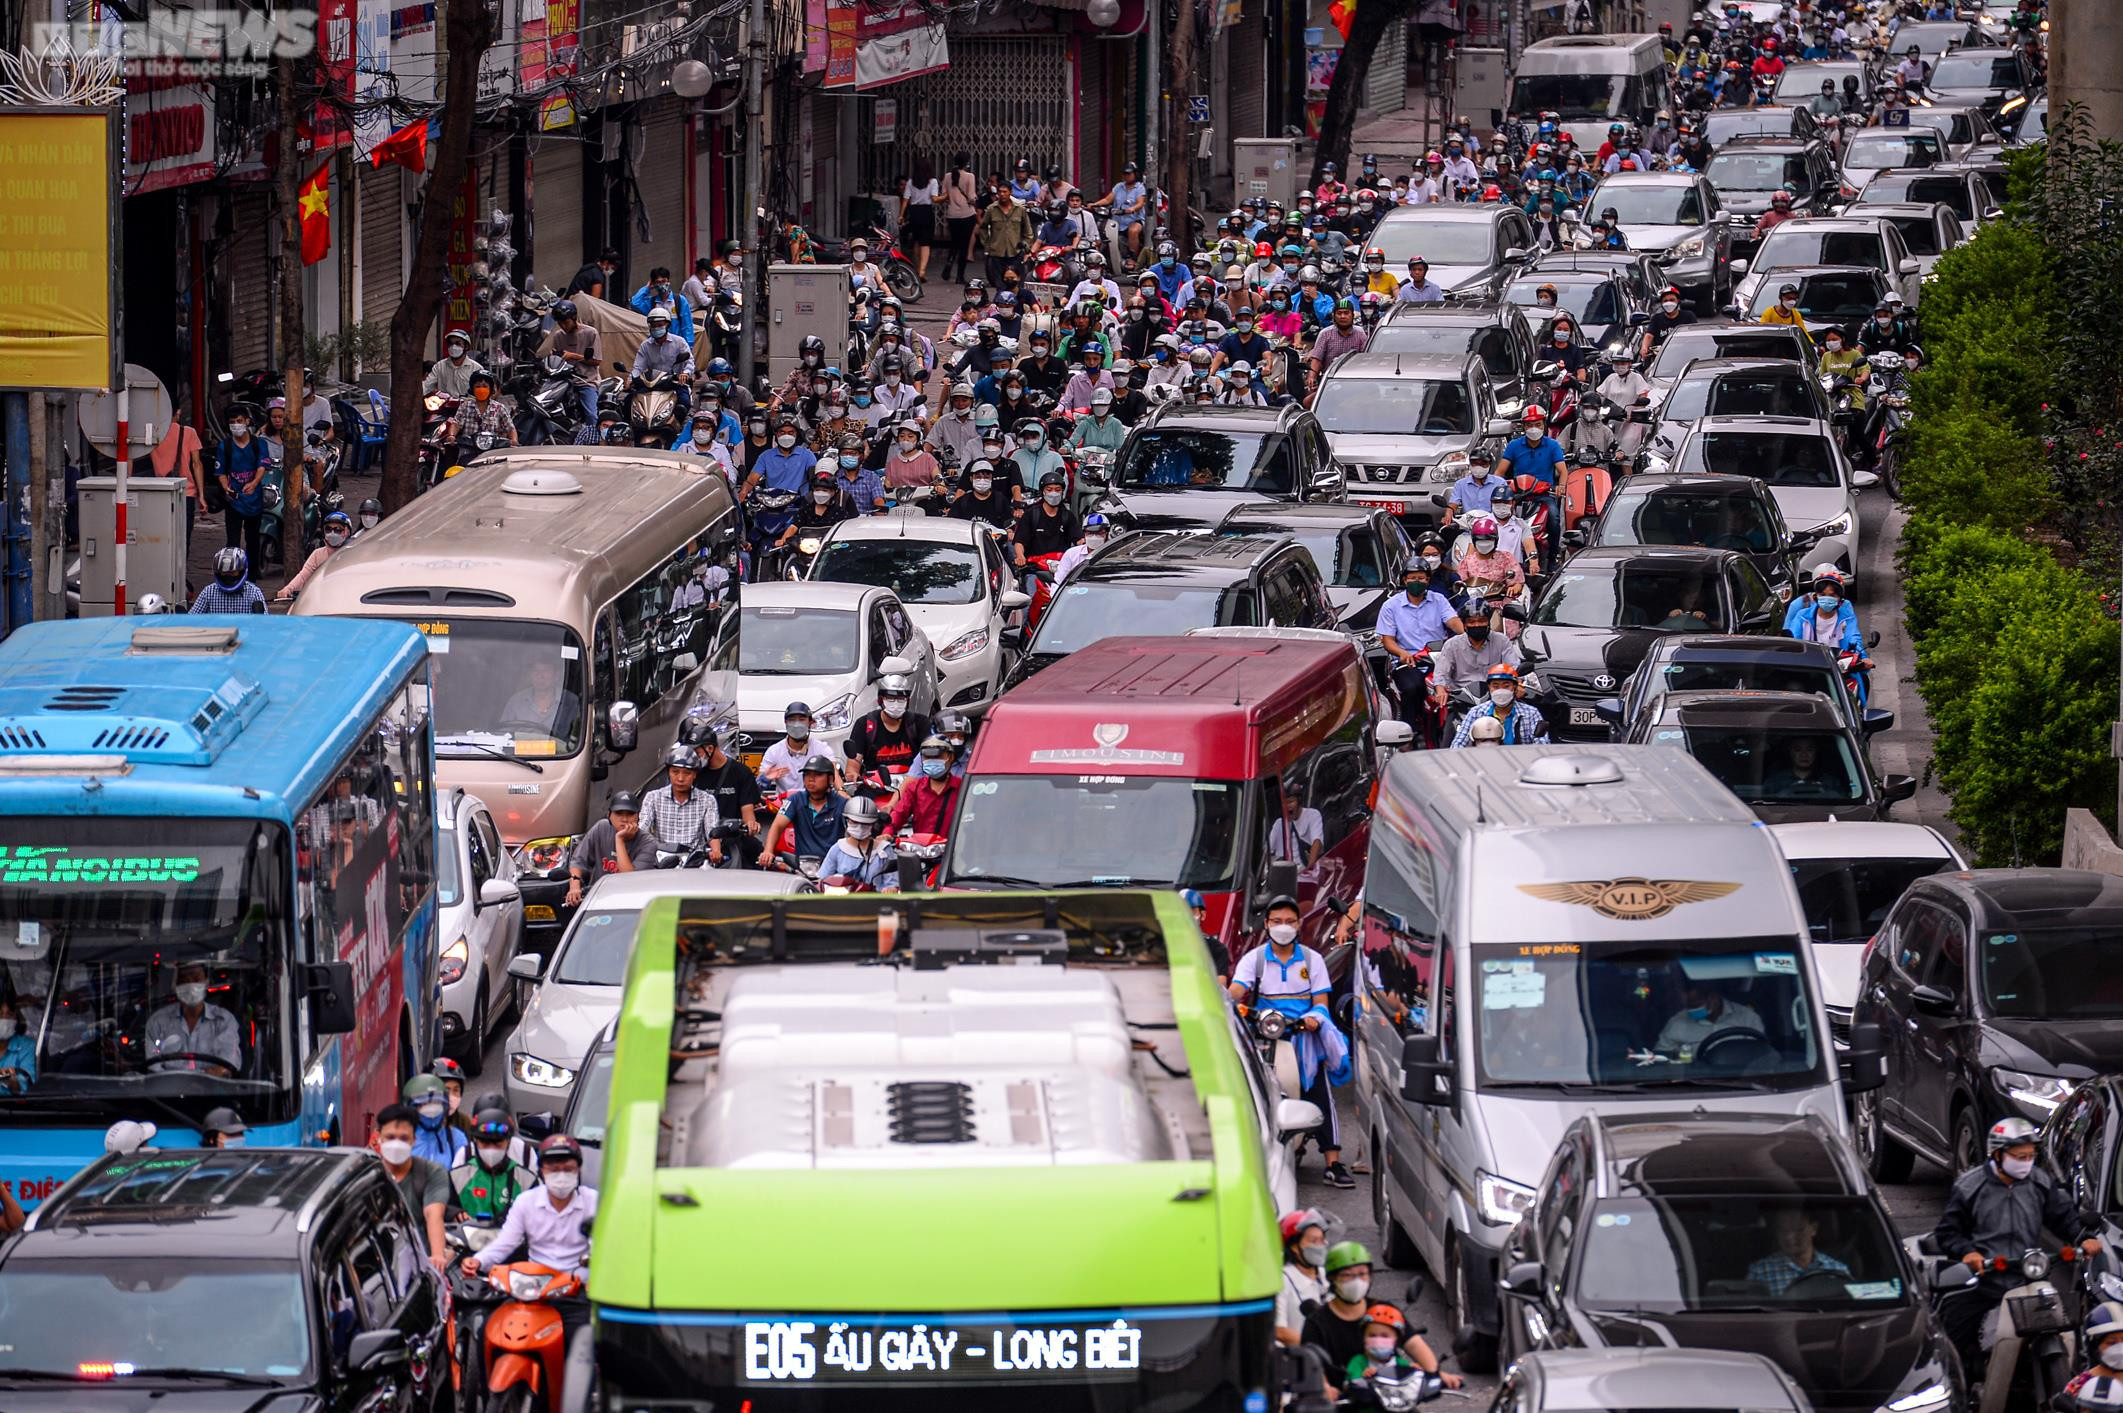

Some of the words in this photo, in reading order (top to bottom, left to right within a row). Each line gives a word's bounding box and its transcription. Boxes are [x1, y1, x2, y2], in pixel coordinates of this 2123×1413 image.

[18, 142, 59, 164] NHÂN
[1032, 749, 1184, 763] LIMOUSINE
[1079, 775, 1088, 784] XE
[745, 1322, 816, 1380] E05
[993, 1329, 1078, 1370] LONG
